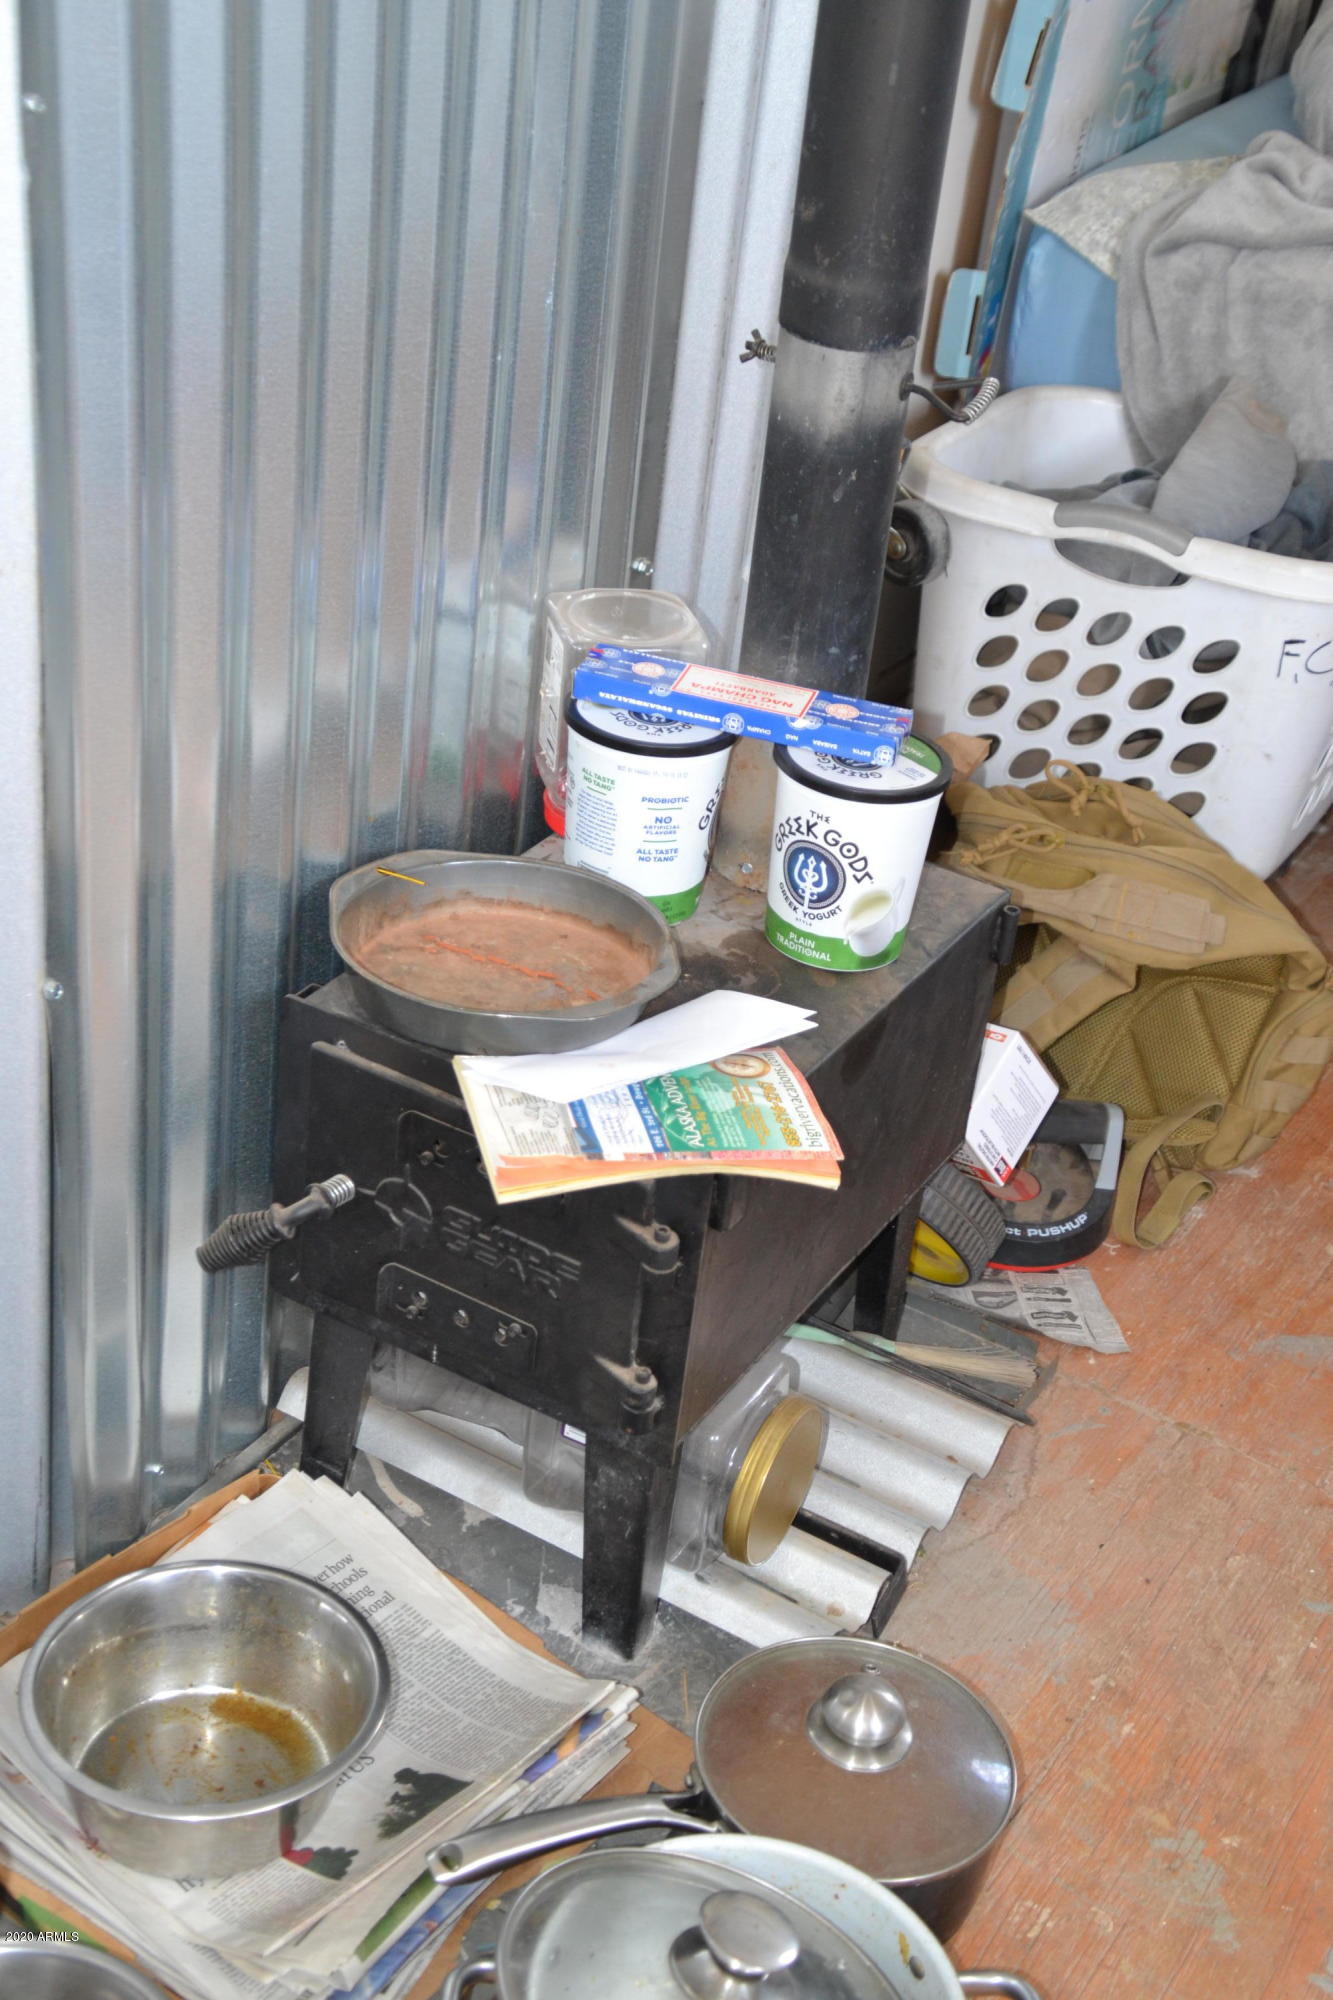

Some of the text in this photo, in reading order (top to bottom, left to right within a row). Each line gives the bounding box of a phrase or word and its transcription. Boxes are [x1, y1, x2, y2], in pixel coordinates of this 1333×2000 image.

[690, 681, 764, 704] CHAMPA
[764, 696, 795, 710] NAG
[746, 725, 772, 736] CHAMPA
[785, 733, 799, 742] NAG
[582, 767, 616, 786] ALL TASTE
[641, 796, 690, 805] PROBIOTIC
[654, 816, 673, 825] NO
[810, 809, 832, 824] THE
[636, 848, 679, 856] ALL TASTE
[638, 855, 652, 863] NO
[775, 816, 873, 884] GREEK GODS
[779, 881, 843, 921] GREEK YOGURT
[776, 932, 832, 962] TRADITIONAL
[789, 931, 816, 949] PLAIN
[762, 1052, 823, 1148] bigrivervacations.com
[675, 1102, 705, 1148] ALASKA
[1026, 1213, 1088, 1237] PUSHUP
[324, 1553, 355, 1575] how
